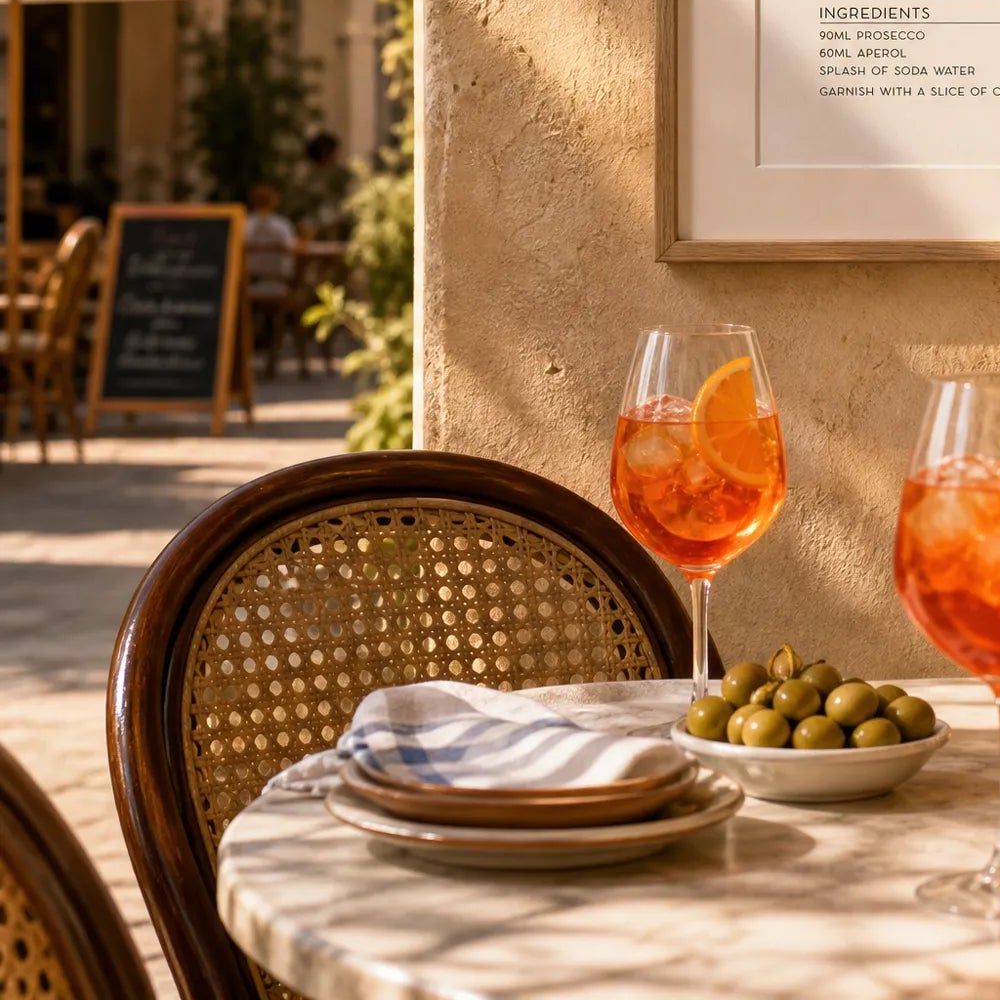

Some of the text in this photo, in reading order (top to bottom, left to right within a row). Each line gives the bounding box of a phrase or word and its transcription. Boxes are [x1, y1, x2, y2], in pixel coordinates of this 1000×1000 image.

[819, 7, 931, 20] INGREDIENTS
[819, 30, 926, 41] 90ML PROSECCO
[819, 48, 907, 59] 60ML APEROL
[819, 65, 976, 76] SPLASH OF SODA WATER
[819, 86, 875, 97] GARNISH
[880, 86, 912, 97] WITH
[917, 87, 926, 97] A
[931, 86, 965, 97] SLICE
[970, 86, 988, 97] OF
